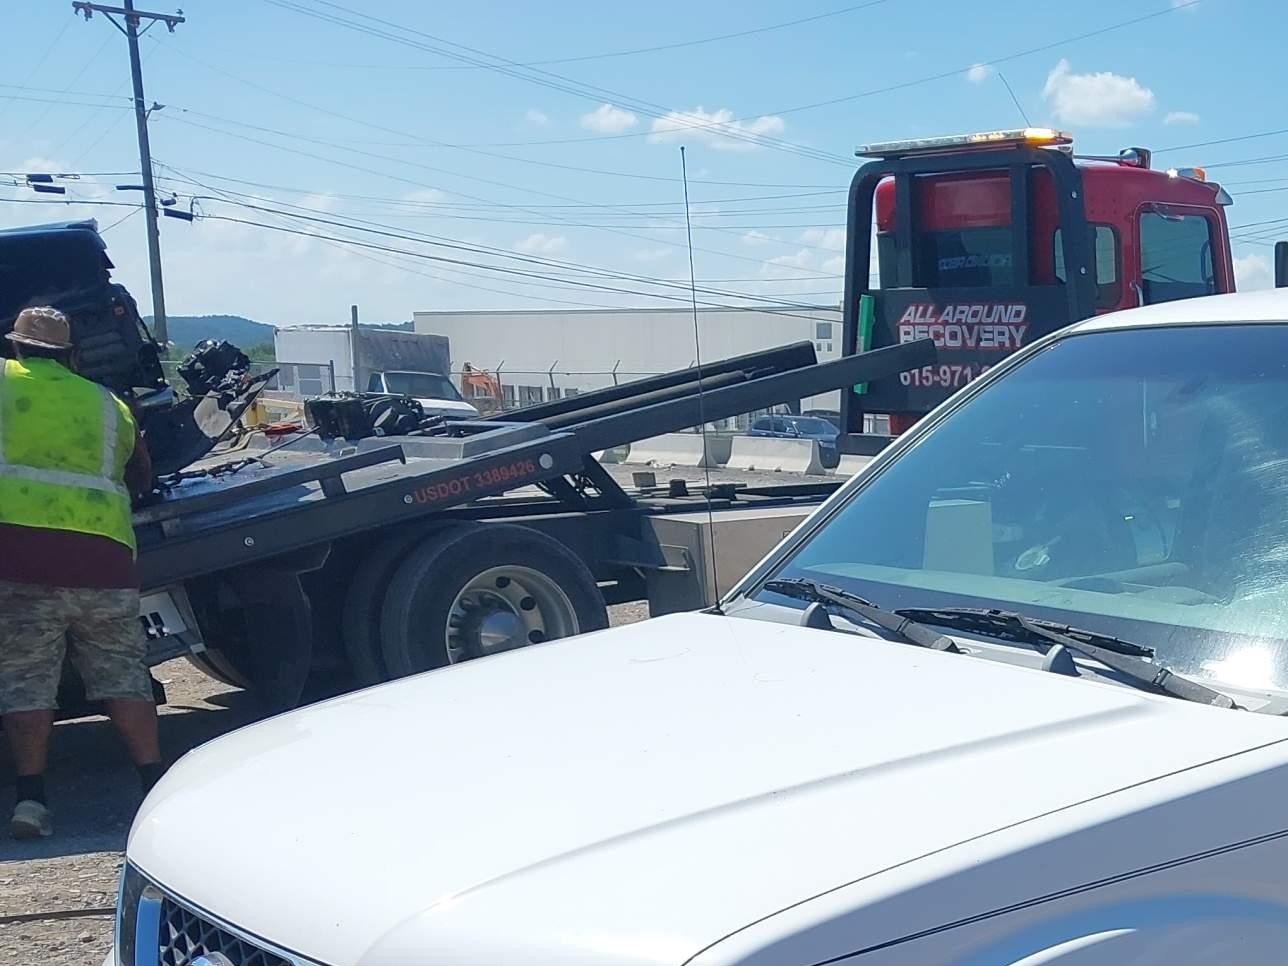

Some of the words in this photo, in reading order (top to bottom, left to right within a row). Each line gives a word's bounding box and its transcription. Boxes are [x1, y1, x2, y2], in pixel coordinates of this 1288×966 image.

[900, 305, 936, 323] ALL
[938, 305, 1026, 323] AROUND
[899, 325, 1026, 347] RECOVERY
[416, 477, 471, 503] USDOT
[473, 460, 535, 487] 3389426
